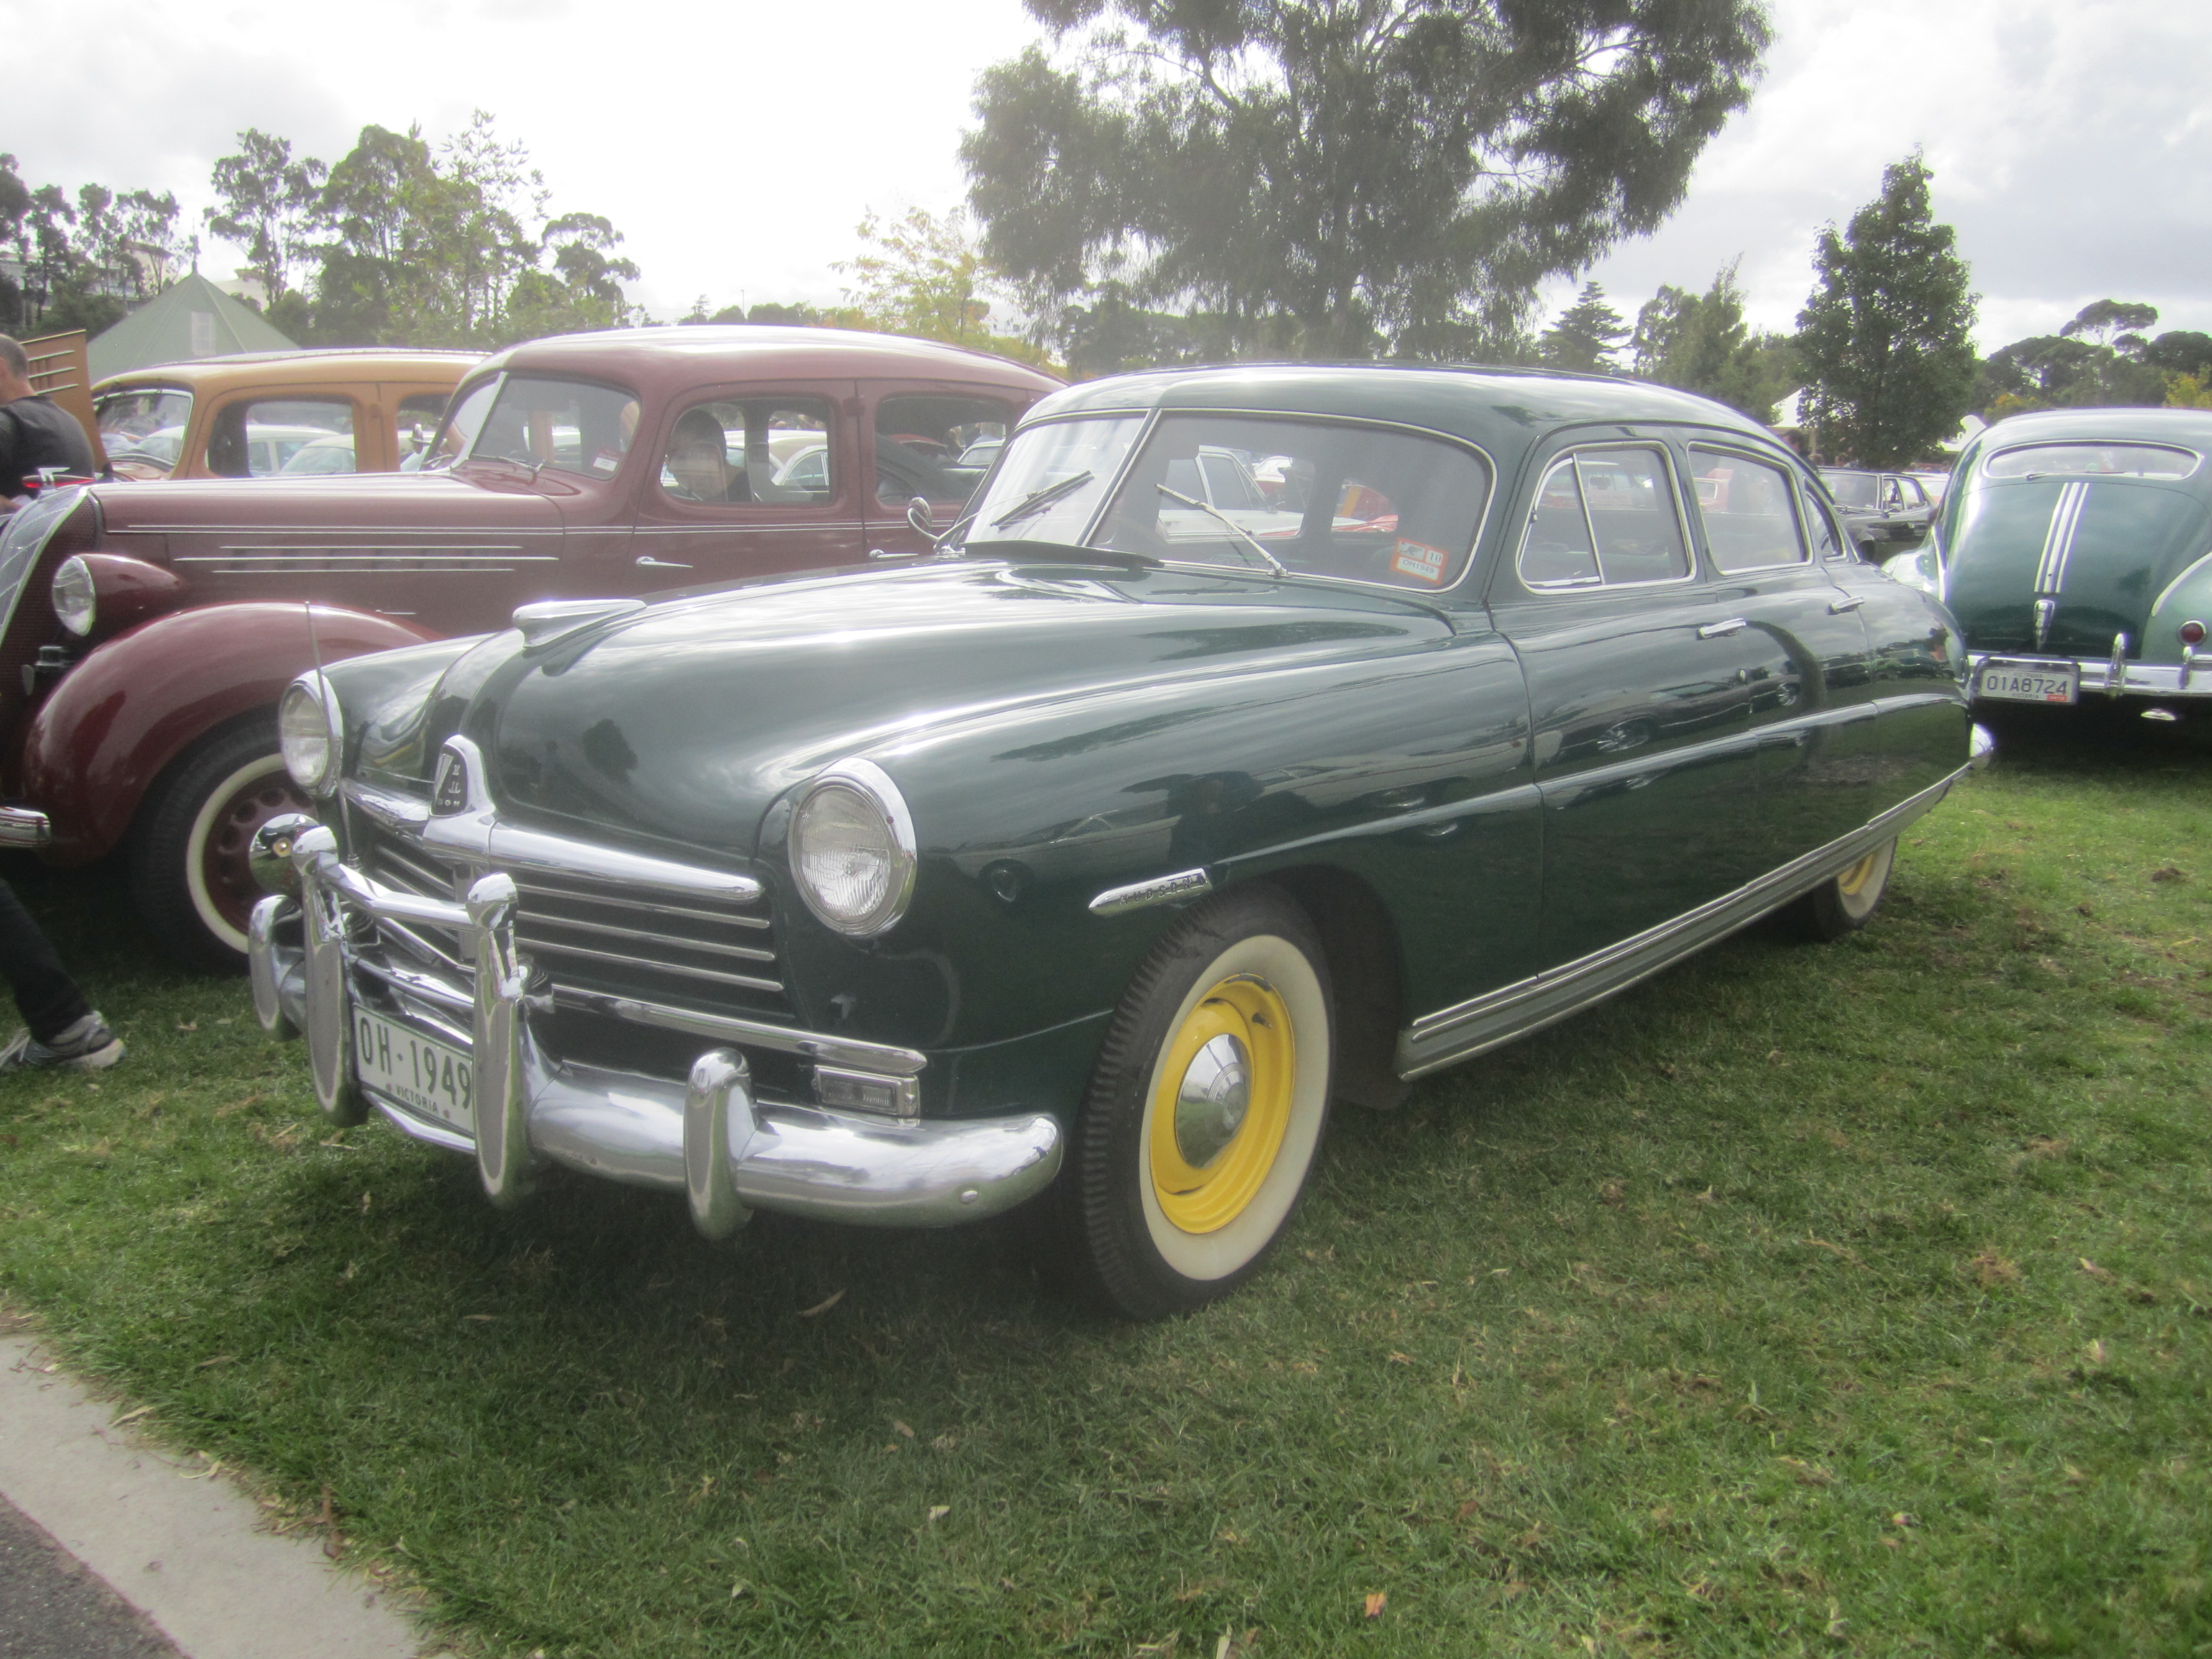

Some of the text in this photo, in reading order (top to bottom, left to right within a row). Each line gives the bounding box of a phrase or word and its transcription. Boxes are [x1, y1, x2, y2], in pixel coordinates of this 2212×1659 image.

[1402, 559, 1434, 573] OH1949
[1429, 552, 1442, 563] 10
[1119, 876, 1192, 907] HUDSON
[395, 1084, 438, 1113] VICTORIA
